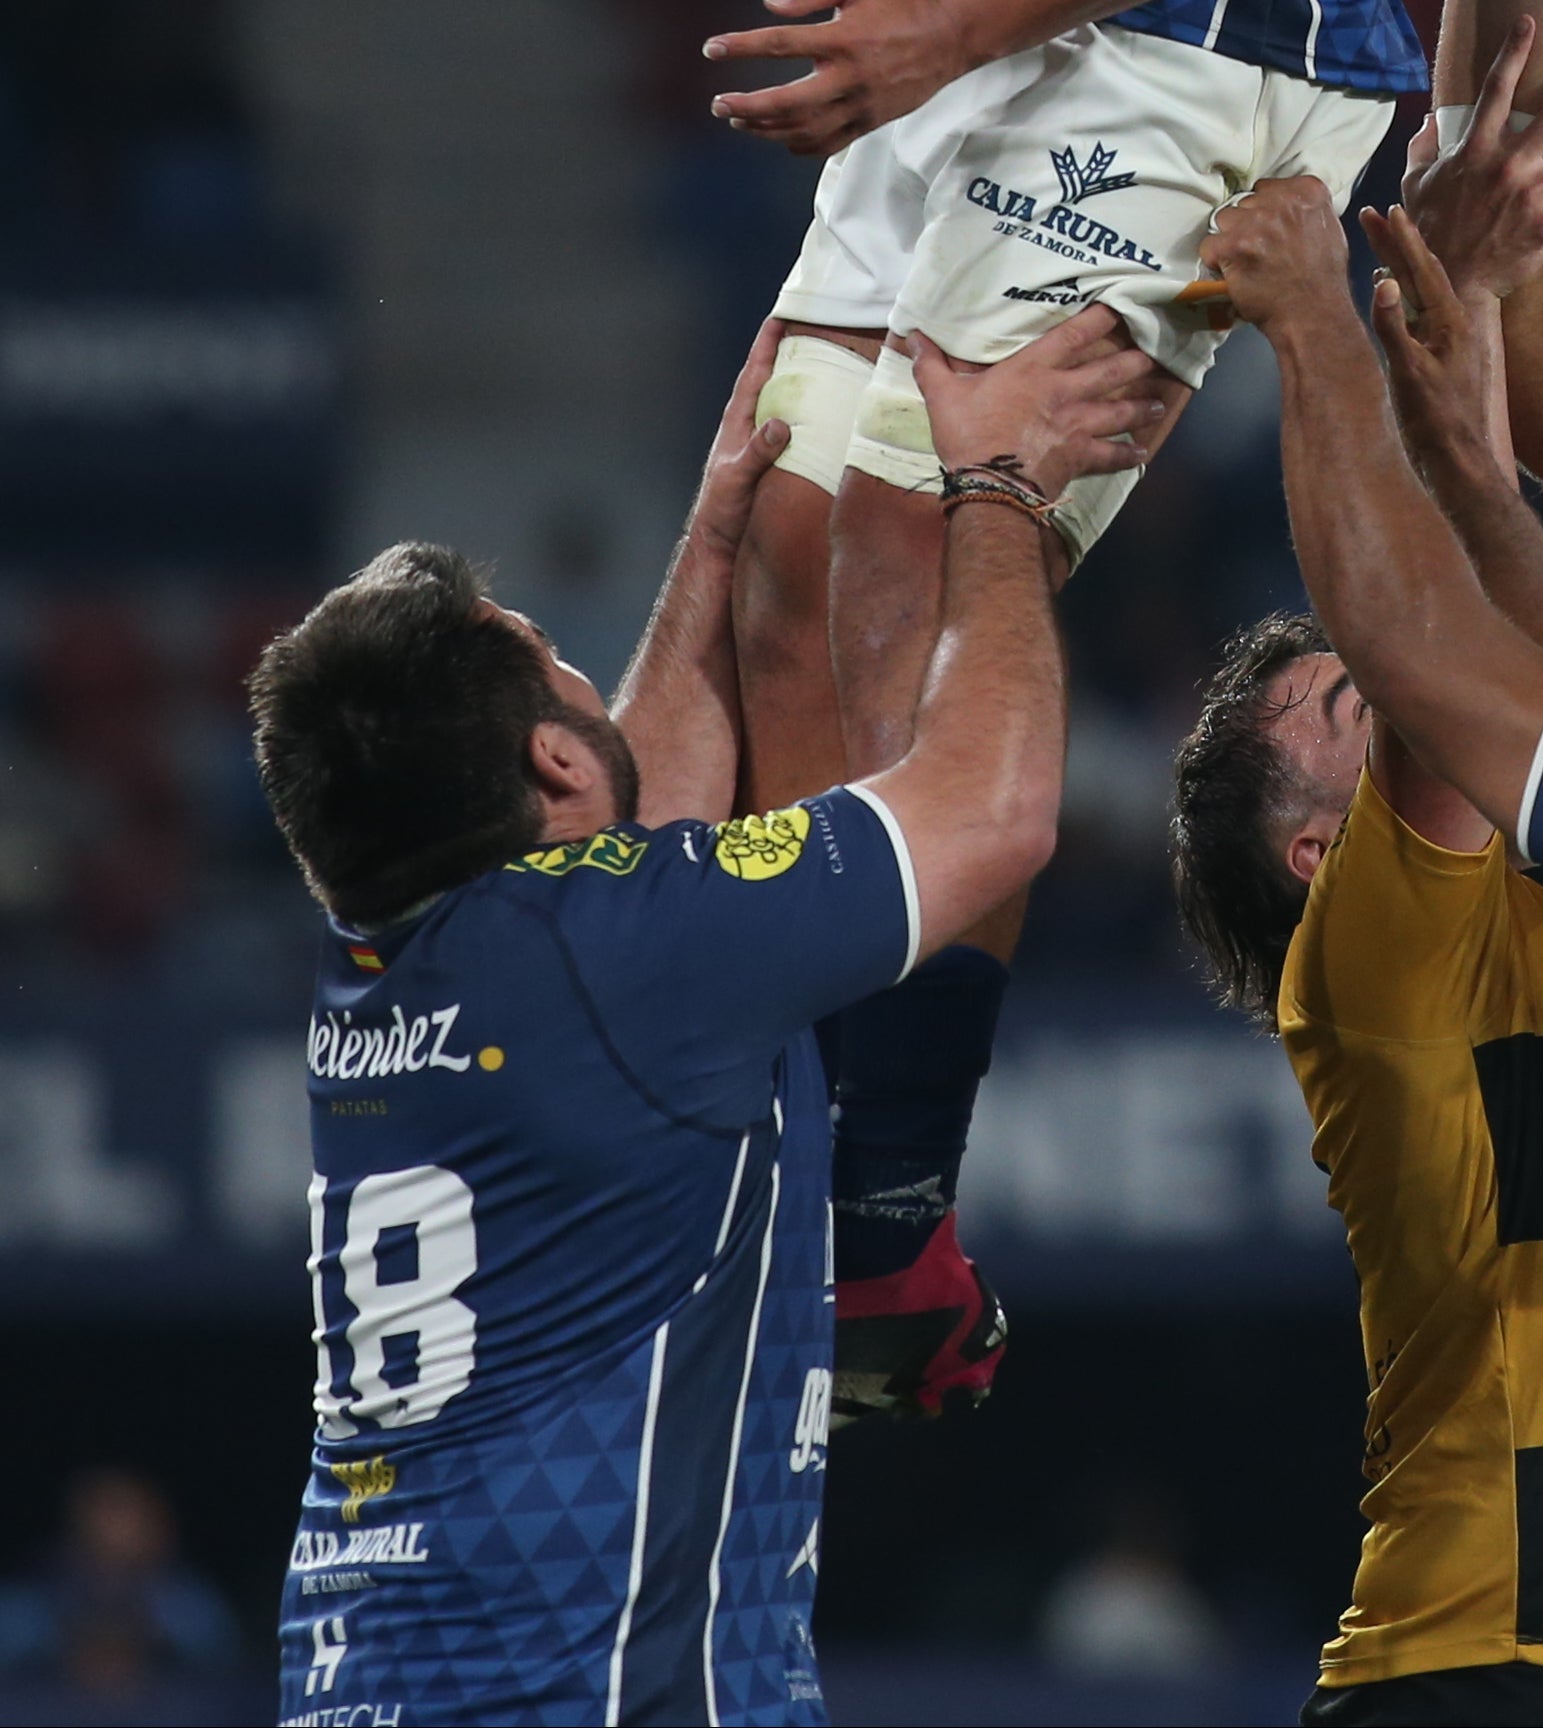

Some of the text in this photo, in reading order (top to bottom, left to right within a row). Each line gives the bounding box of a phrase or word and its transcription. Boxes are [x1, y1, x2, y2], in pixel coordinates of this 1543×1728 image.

[966, 177, 1163, 272] CAJA RURAL
[993, 221, 1099, 267] DE ZAMORA
